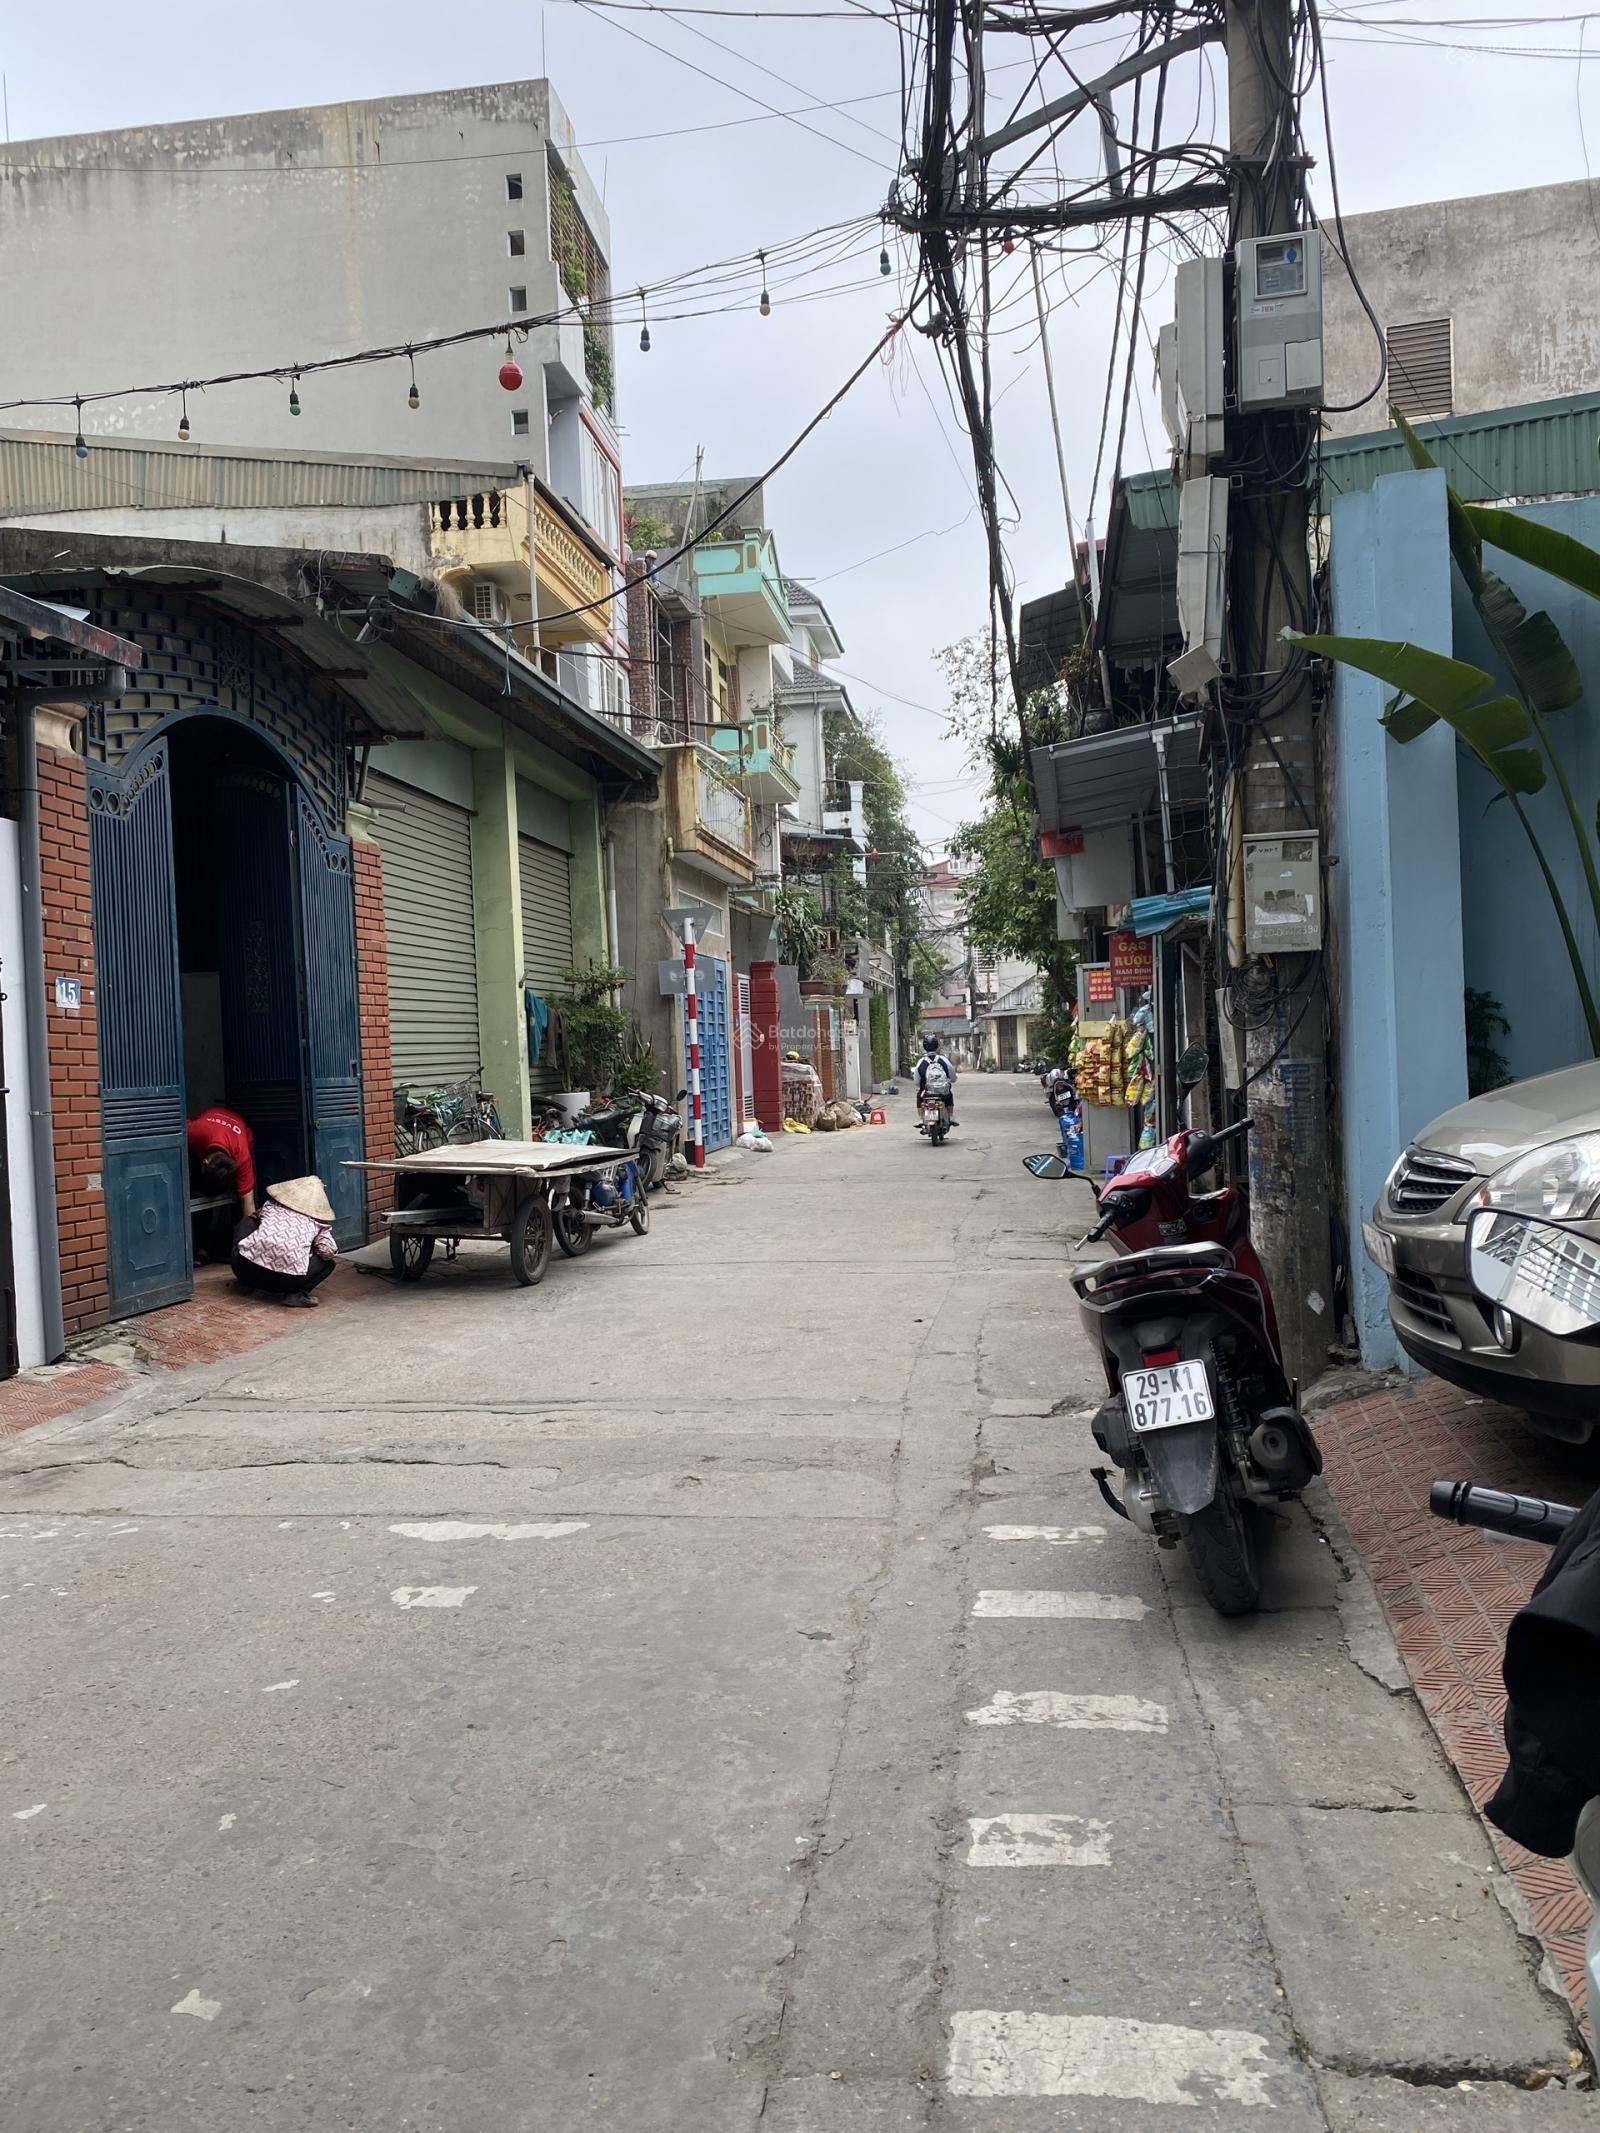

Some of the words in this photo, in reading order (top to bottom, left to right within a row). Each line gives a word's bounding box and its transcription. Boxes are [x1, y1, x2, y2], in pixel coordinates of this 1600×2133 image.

[61, 981, 76, 1003] 15
[1136, 1366, 1194, 1399] 29-K1
[1134, 1392, 1207, 1427] 877.16
